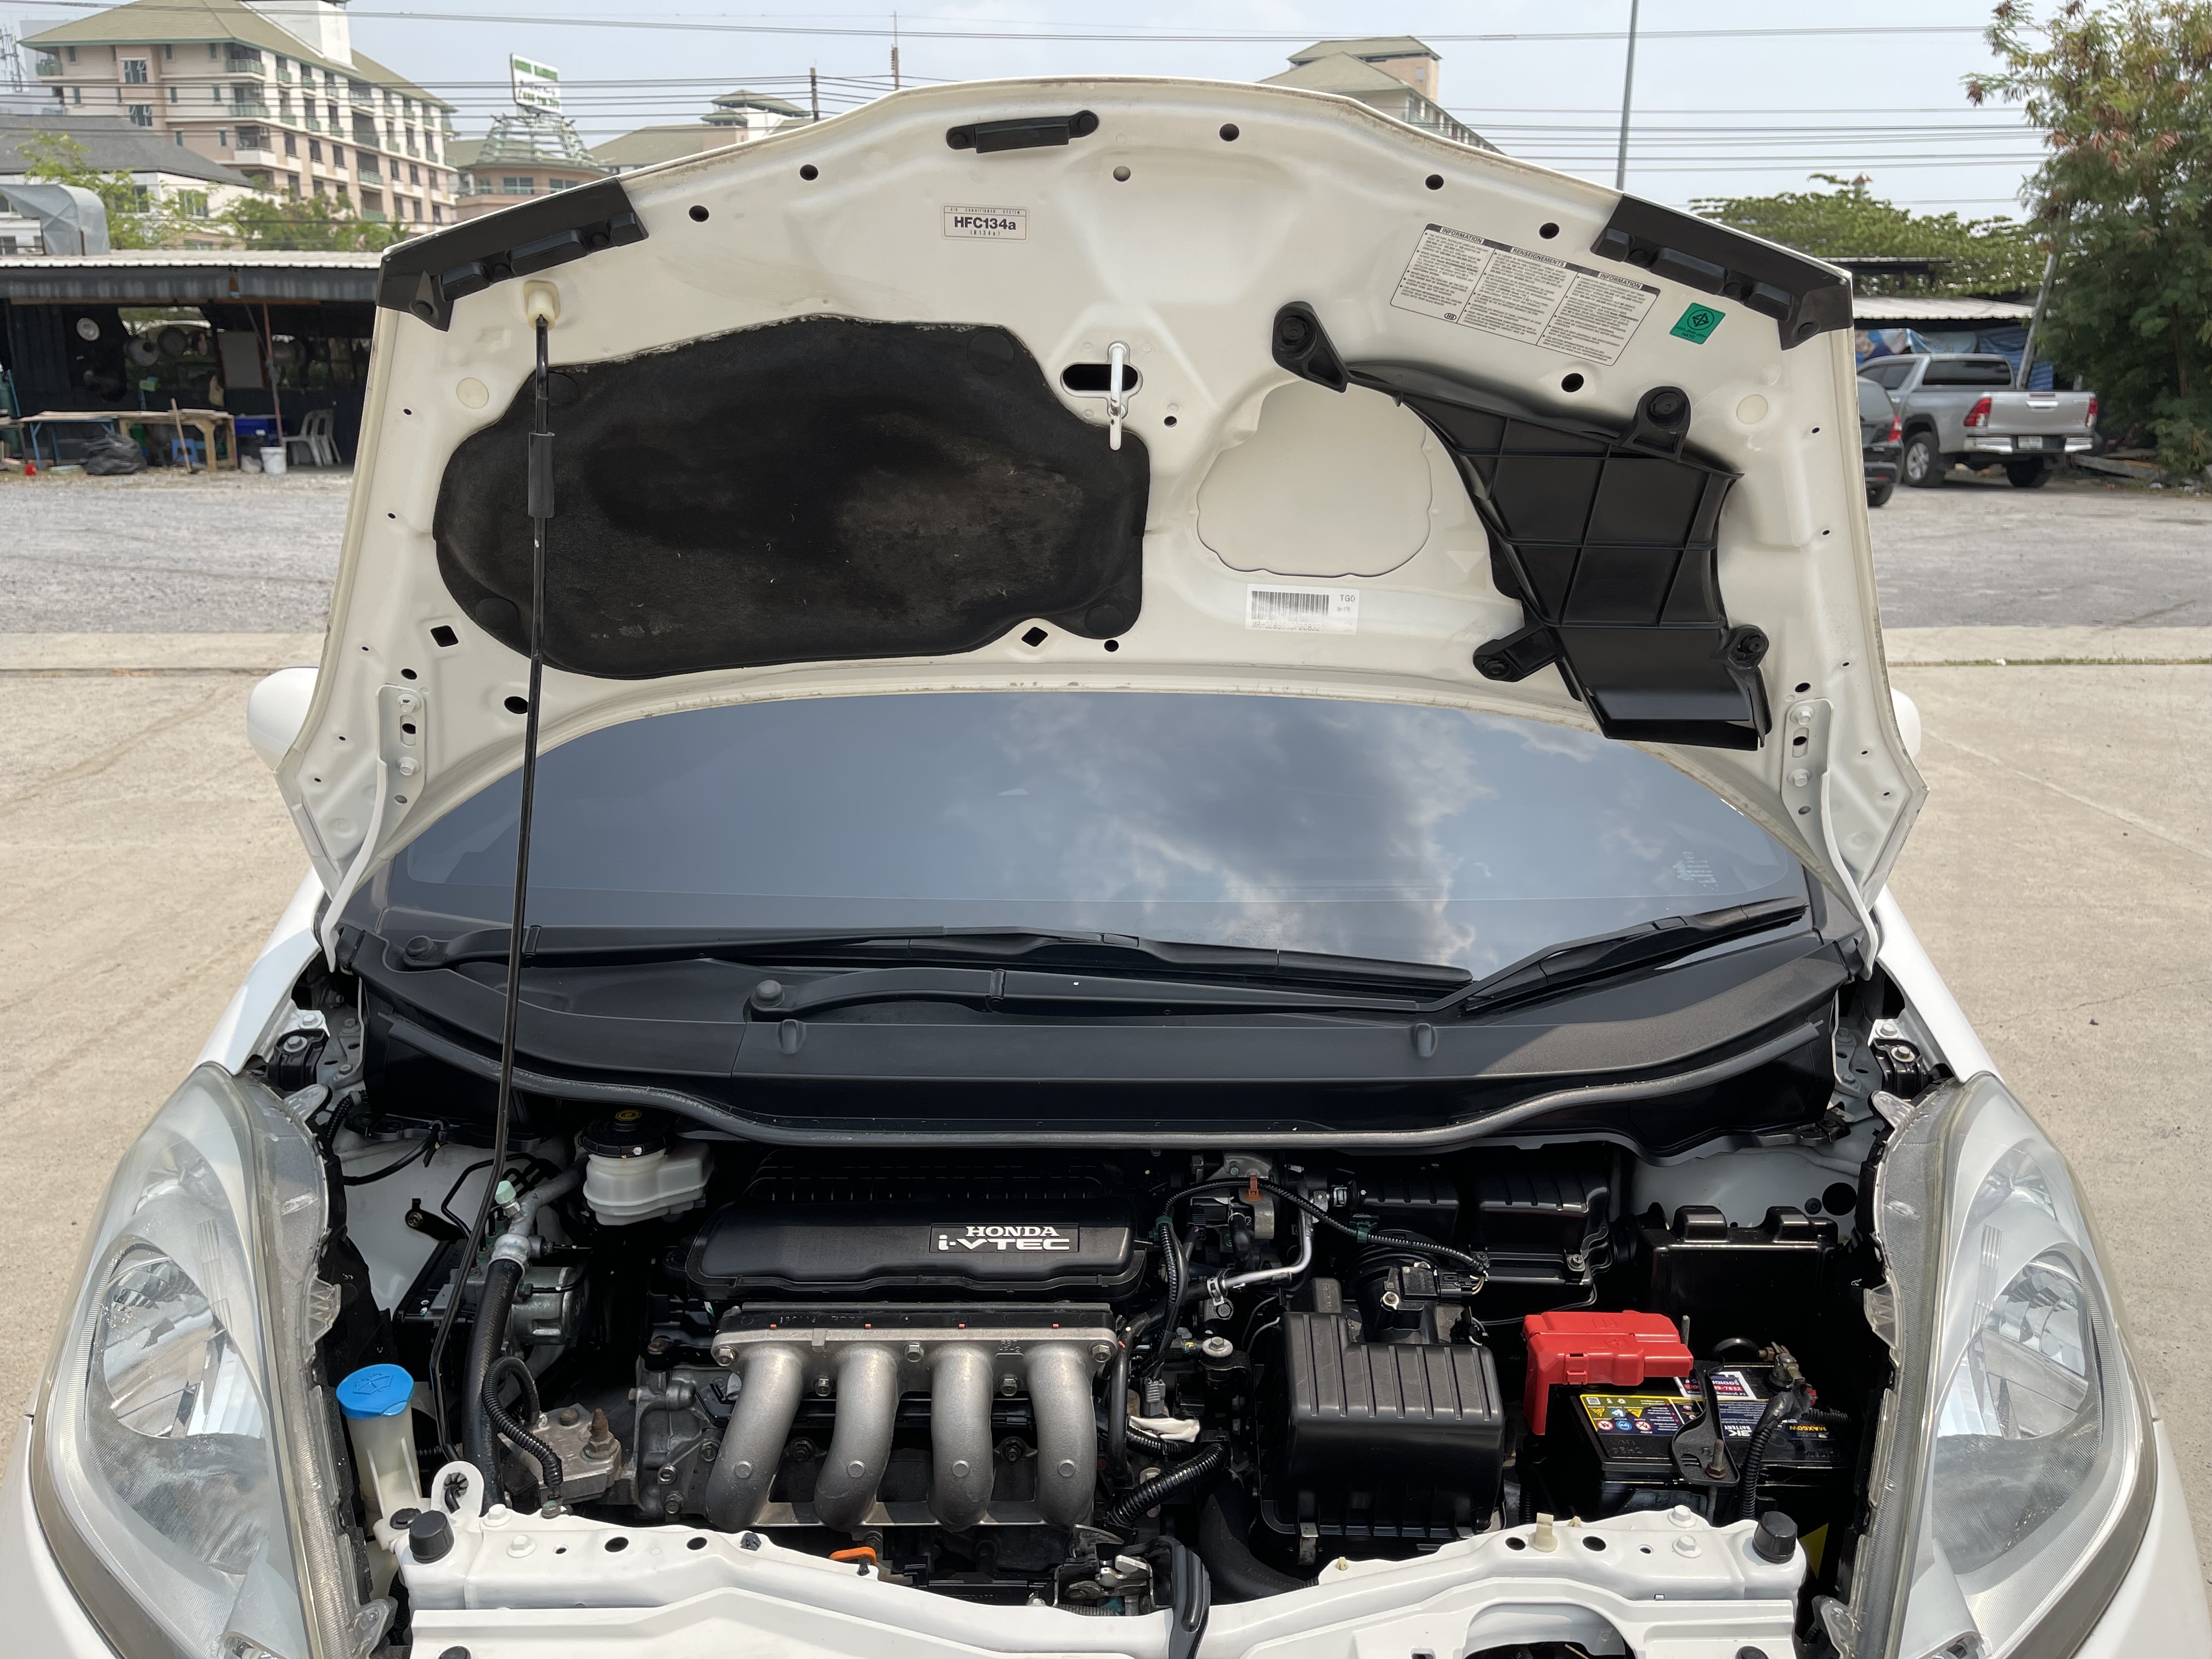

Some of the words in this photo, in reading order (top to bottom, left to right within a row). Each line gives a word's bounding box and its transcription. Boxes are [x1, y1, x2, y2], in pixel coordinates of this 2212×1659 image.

[954, 216, 1016, 230] HFC134a
[1442, 228, 1483, 244] INFORMATION
[1513, 248, 1565, 267] RENSEIGNEMENTS
[1600, 273, 1641, 289] INFORMATION
[965, 1226, 1060, 1237] HONDA
[938, 1234, 1069, 1251] i-VTEC
